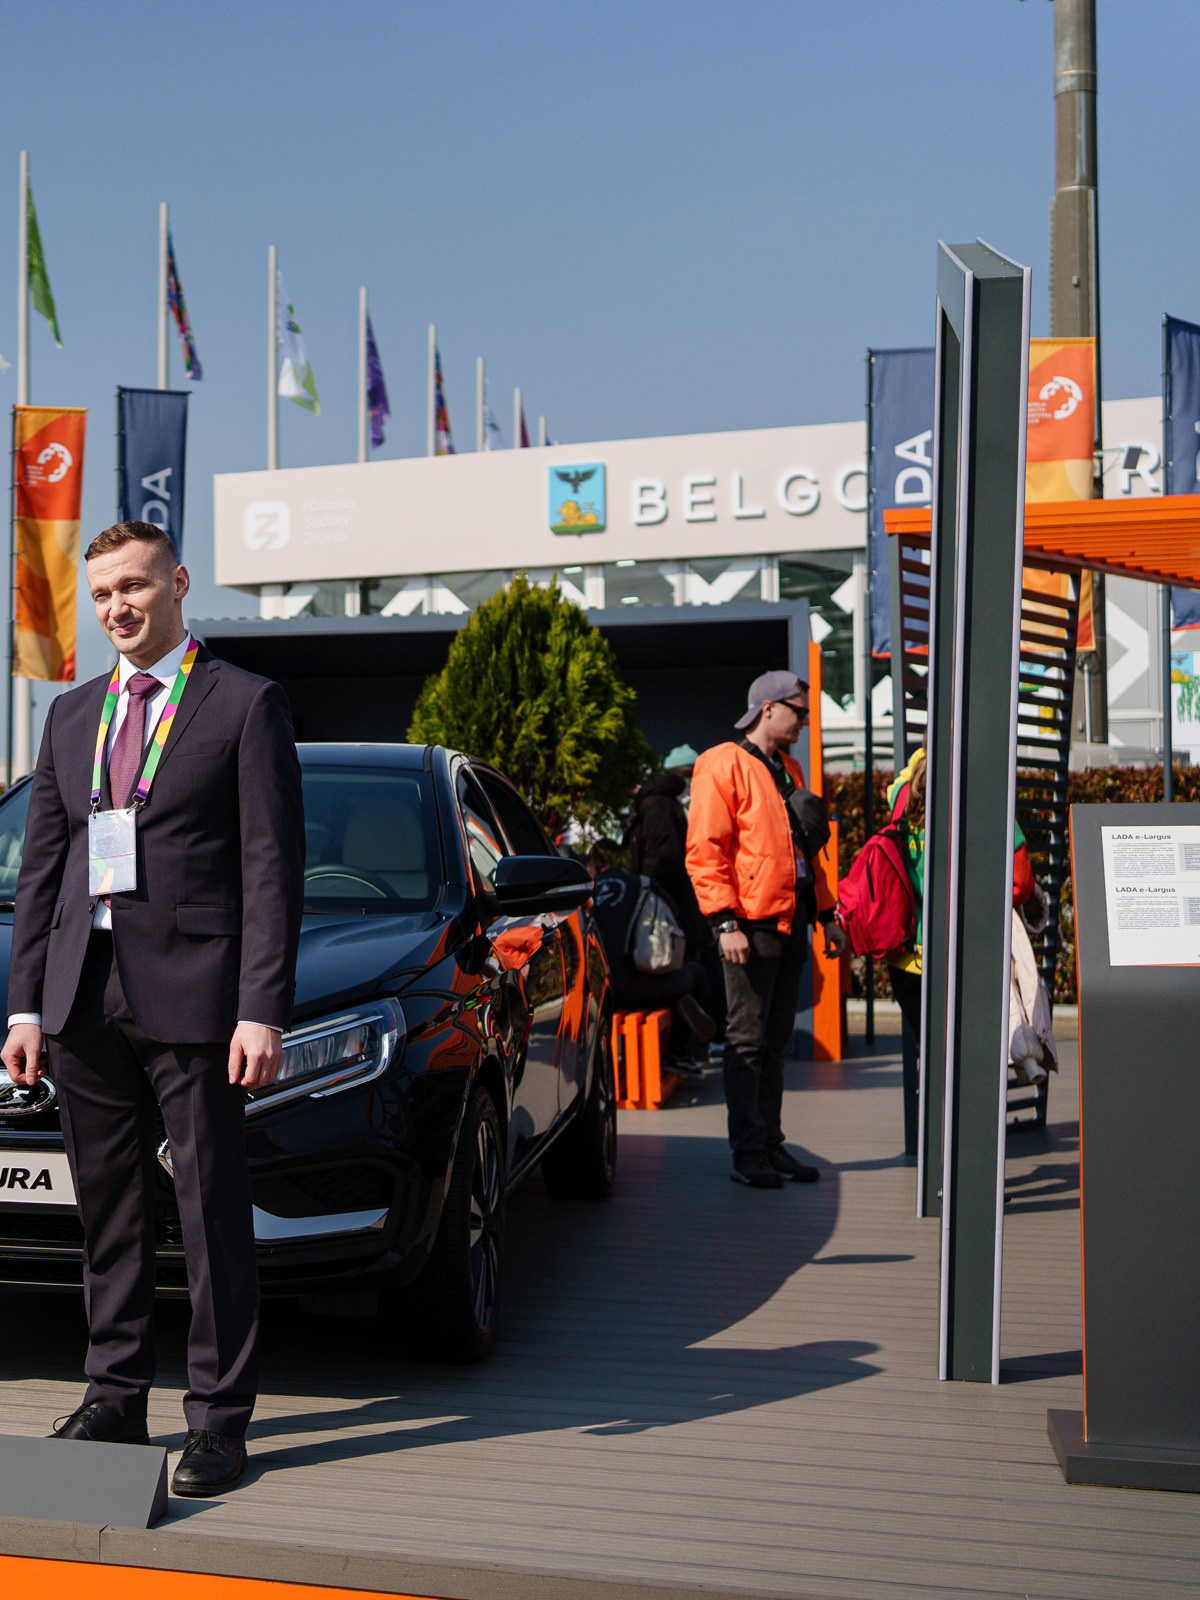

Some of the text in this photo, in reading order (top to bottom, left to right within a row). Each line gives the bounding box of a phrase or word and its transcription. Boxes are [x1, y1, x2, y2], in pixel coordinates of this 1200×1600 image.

[141, 467, 173, 531] DA
[633, 465, 867, 526] BELGO
[895, 429, 932, 505] DA
